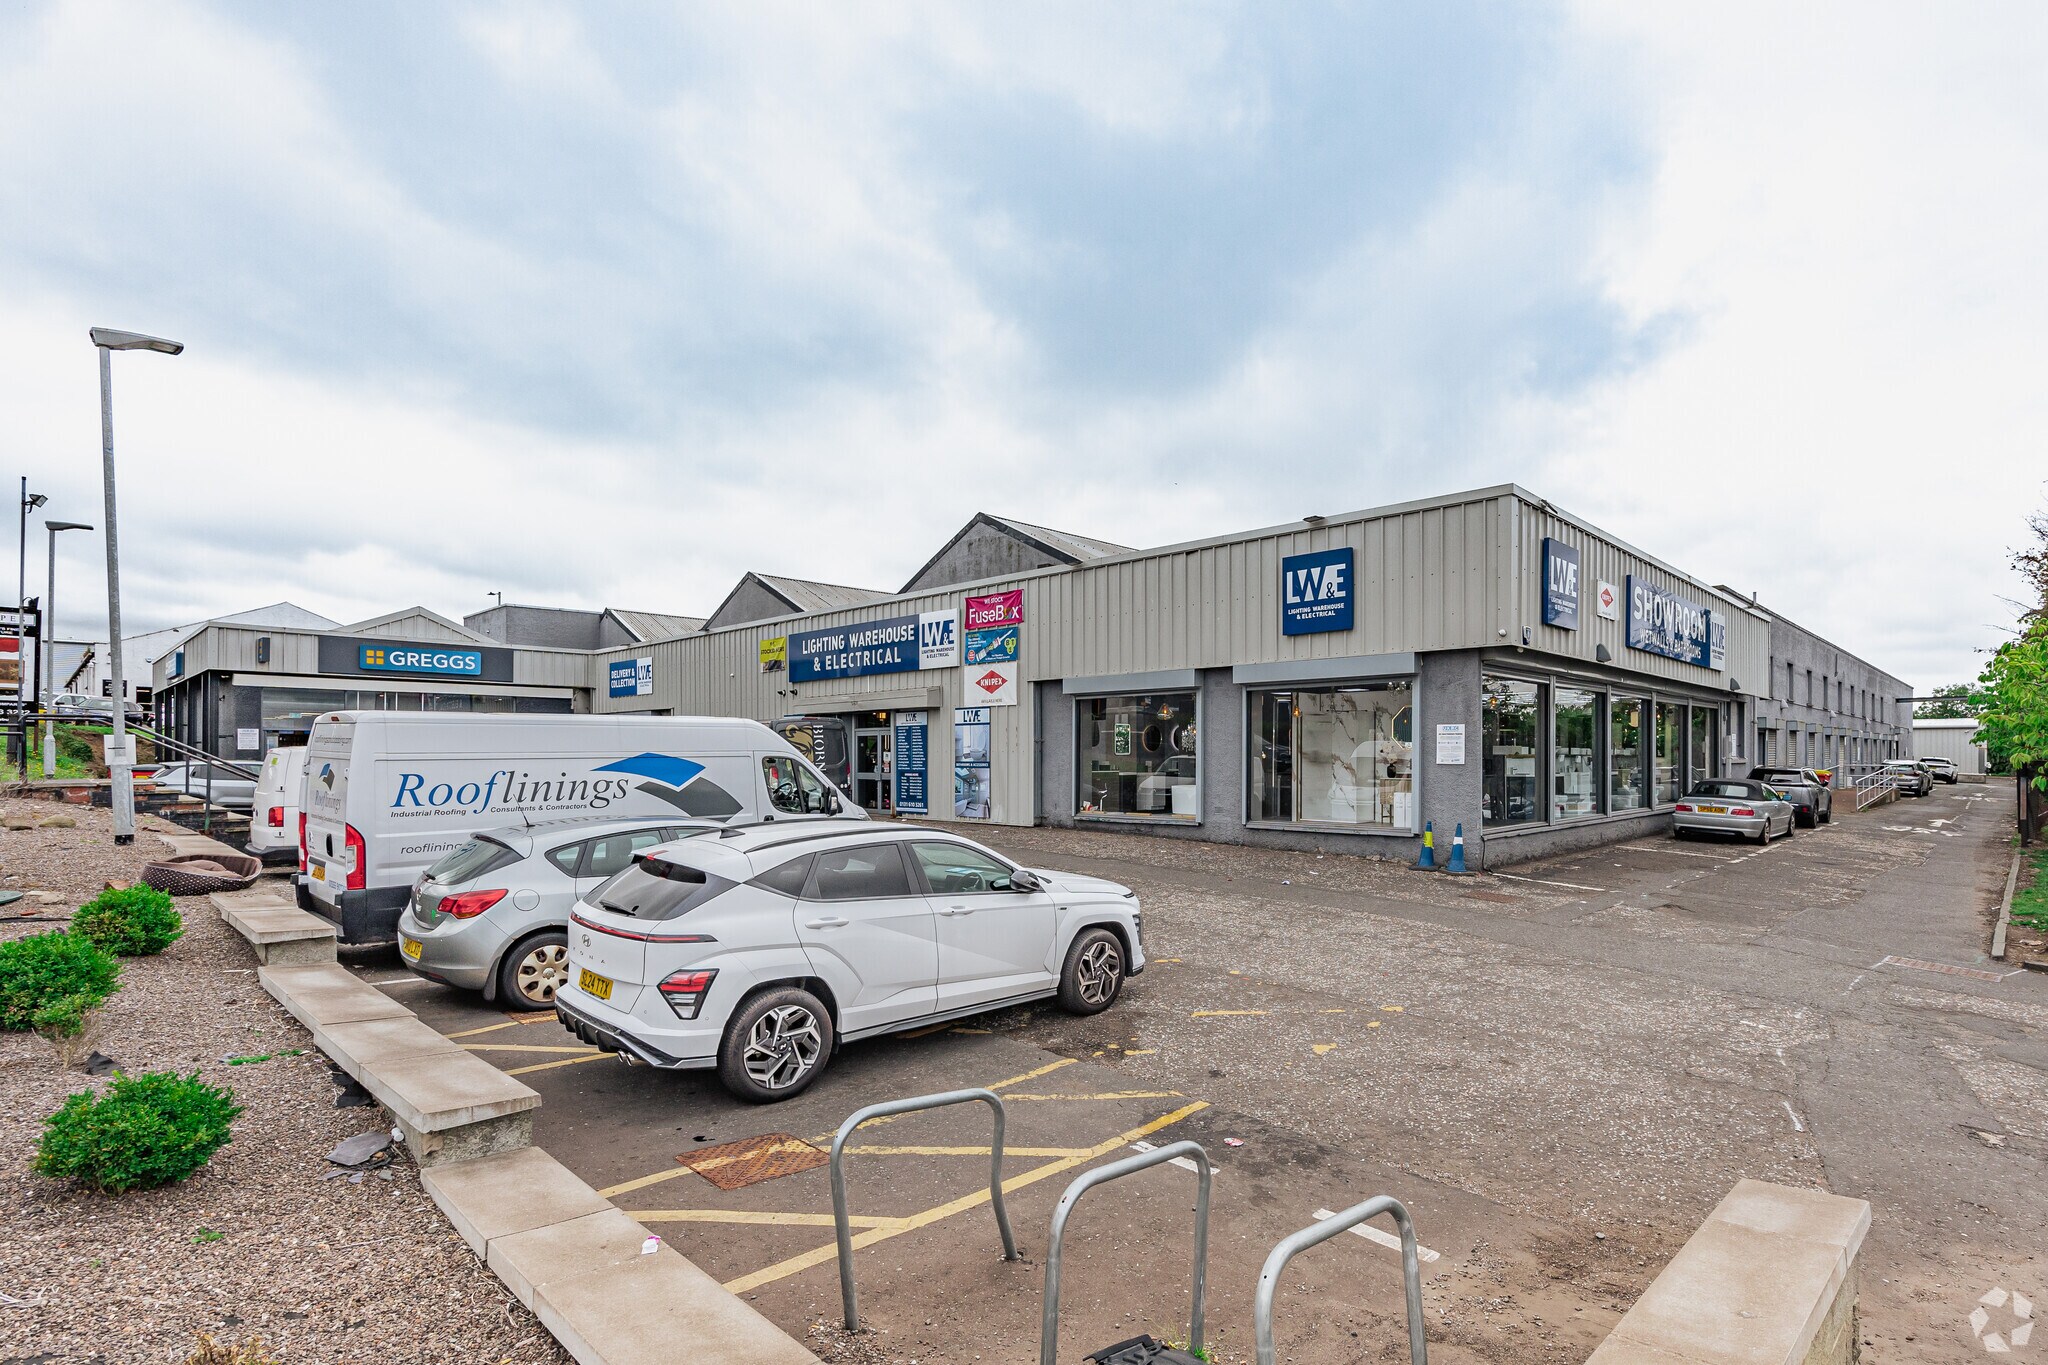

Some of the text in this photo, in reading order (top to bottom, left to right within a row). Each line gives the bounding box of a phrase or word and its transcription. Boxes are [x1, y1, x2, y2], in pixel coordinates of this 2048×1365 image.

[1288, 602, 1344, 615] LIGHTING WAREHOUSE
[1302, 610, 1336, 620] ELECTRICAL
[1634, 586, 1706, 643] SHOWROOM
[802, 624, 915, 655] LIGHTING WAREHOUSE
[390, 652, 476, 670] GREGGS
[814, 647, 902, 672] & ELECTRICAL
[611, 678, 636, 688] COLLECTION
[980, 678, 1002, 686] KNIPEX
[390, 770, 629, 814] Rooflinings
[391, 808, 466, 818] Industrial Roofing
[490, 804, 536, 813] Consultants
[596, 978, 610, 996] TTX
